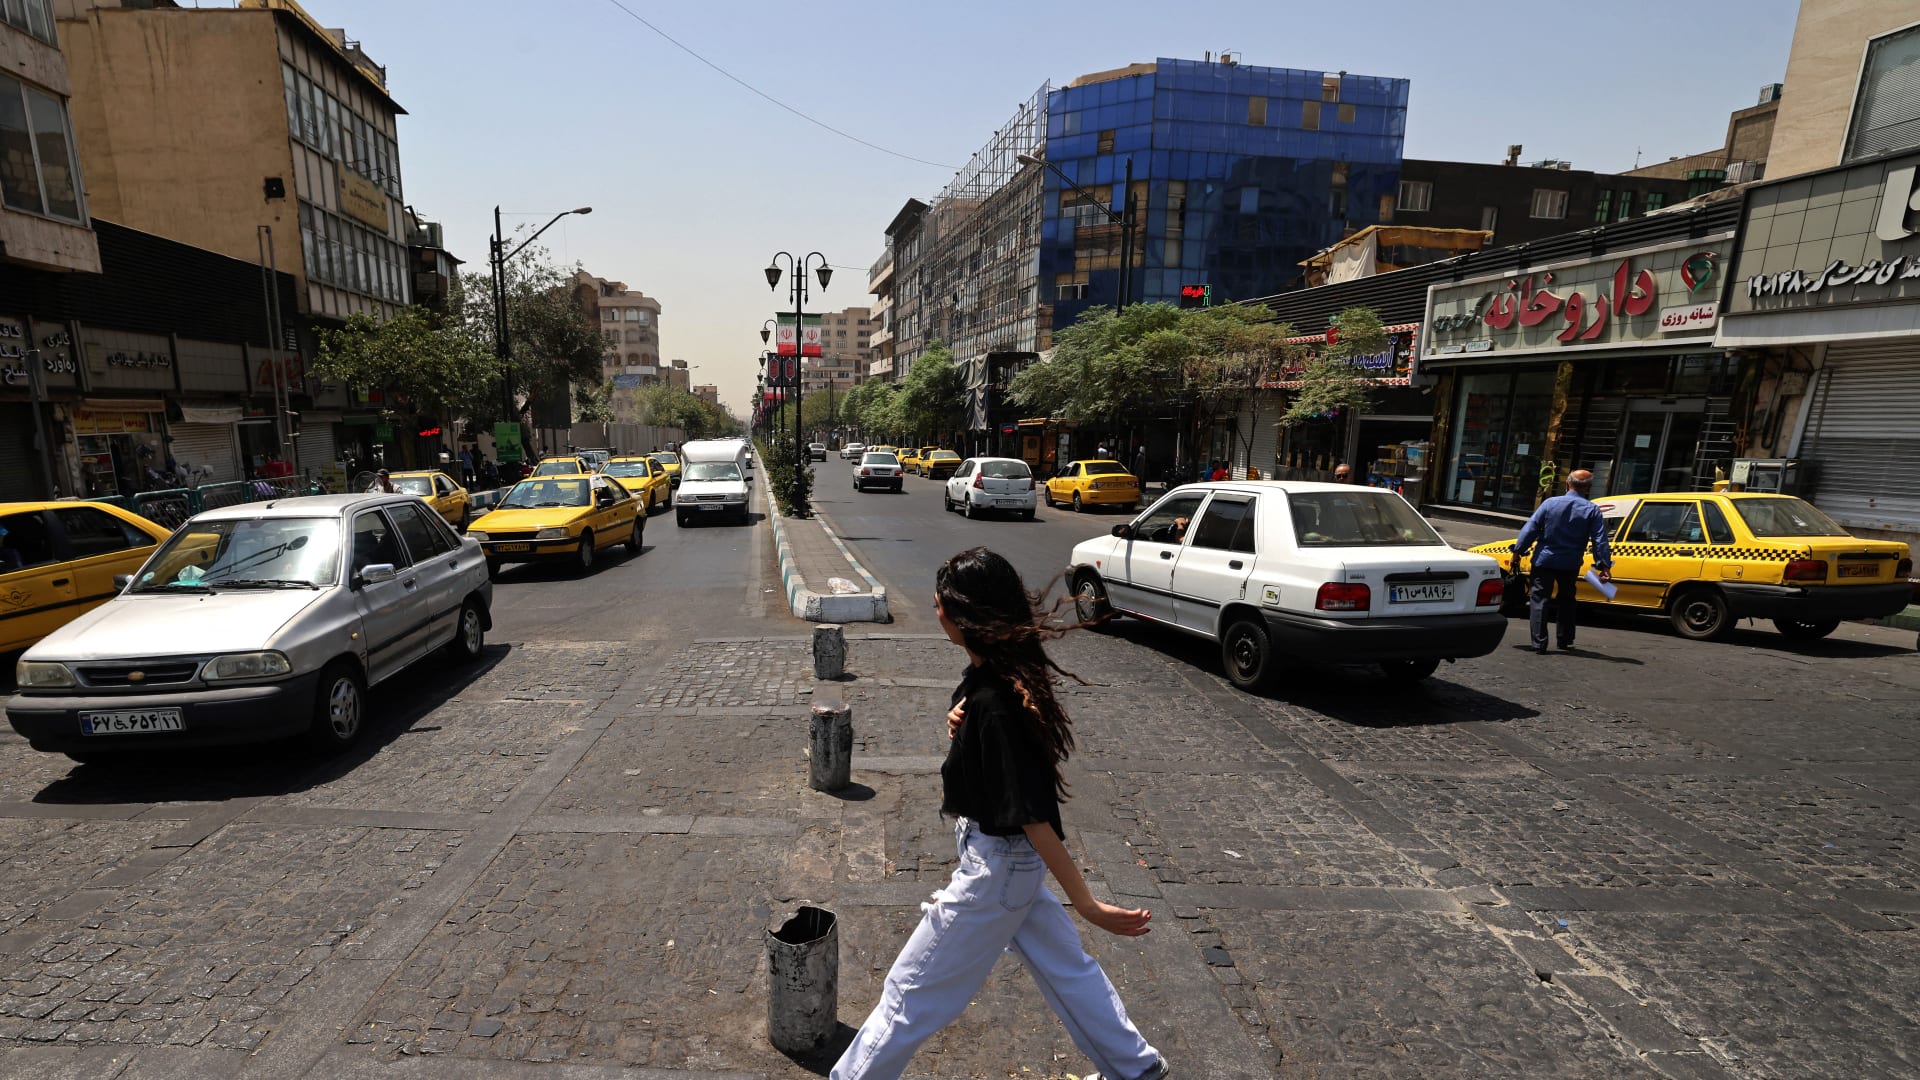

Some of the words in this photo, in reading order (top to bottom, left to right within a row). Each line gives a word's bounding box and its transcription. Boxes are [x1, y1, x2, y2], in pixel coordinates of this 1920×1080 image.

[1484, 259, 1657, 341] داروخانه
[1661, 312, 1687, 327] روزی
[1689, 306, 1714, 324] شبانه
[47, 332, 70, 347] گالری
